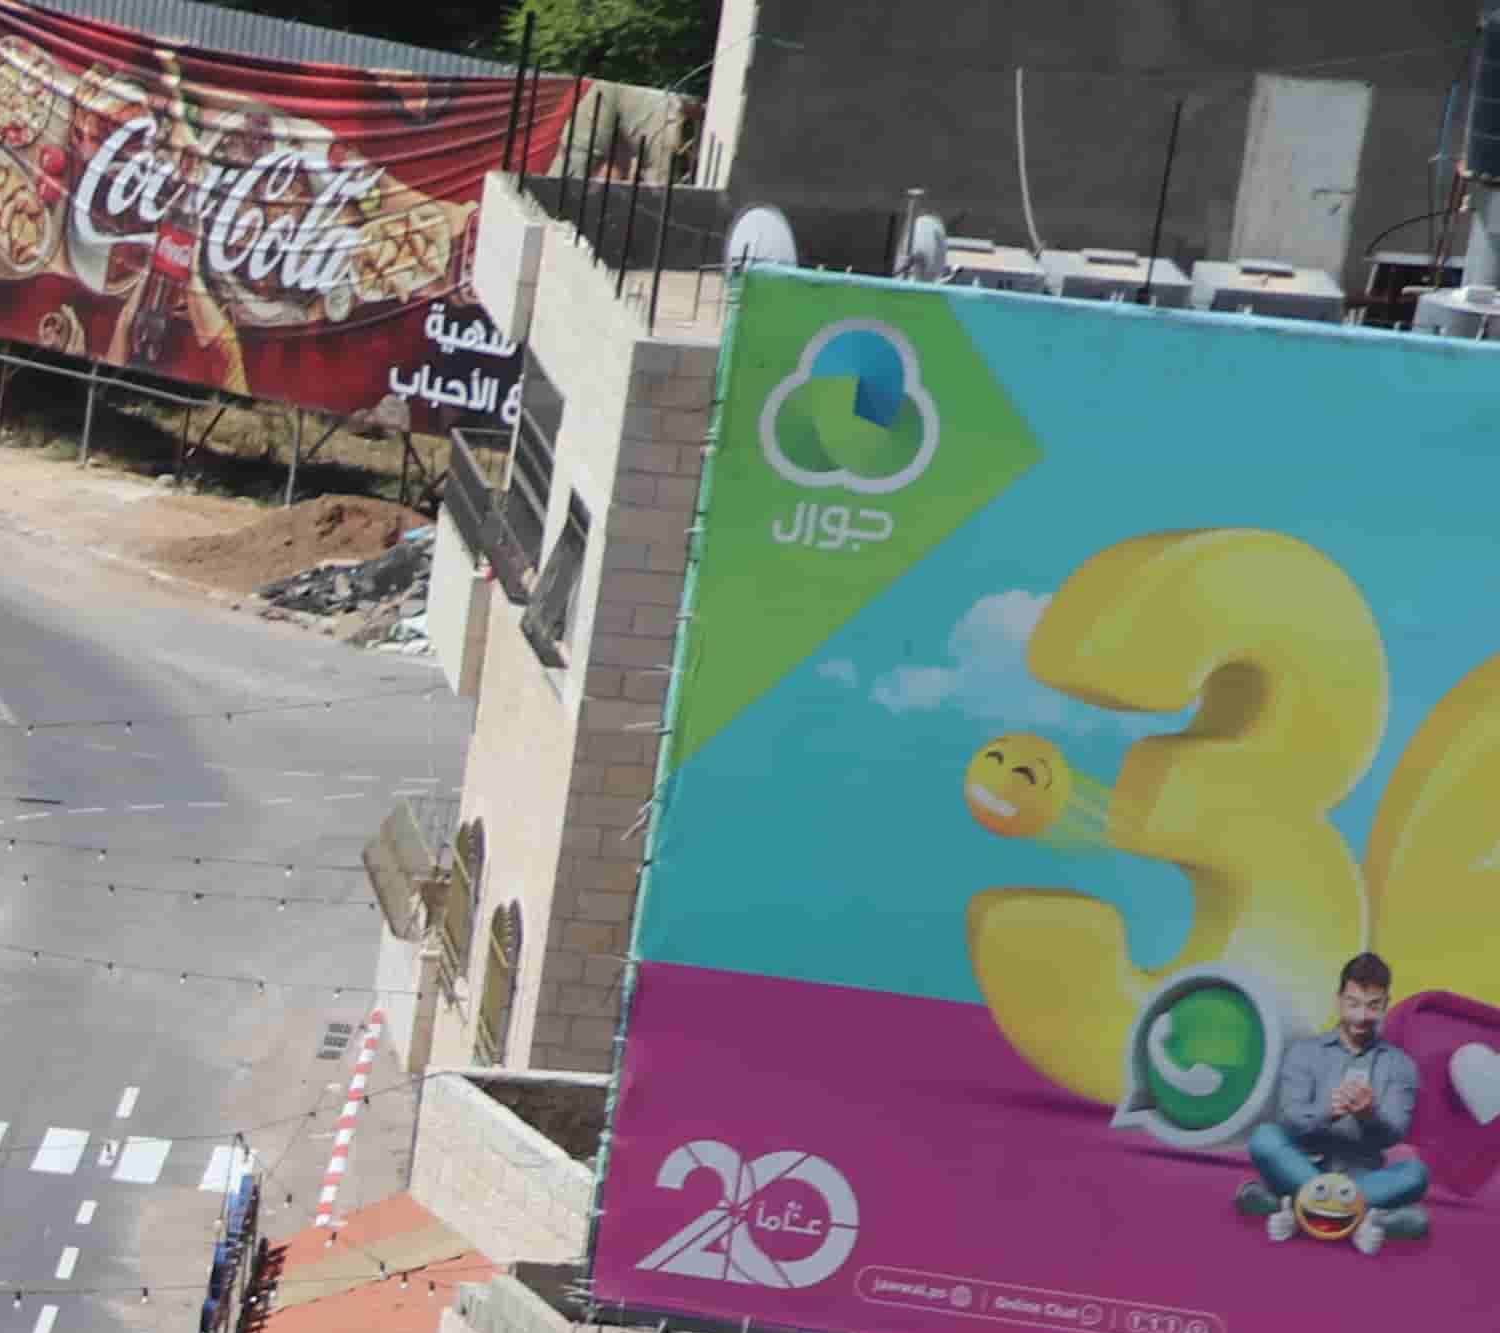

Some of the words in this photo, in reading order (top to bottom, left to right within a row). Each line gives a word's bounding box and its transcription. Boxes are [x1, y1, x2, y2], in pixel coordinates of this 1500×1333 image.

[389, 366, 500, 413] الأحباب
[770, 502, 894, 552] جوال
[635, 1139, 858, 1289] 20
